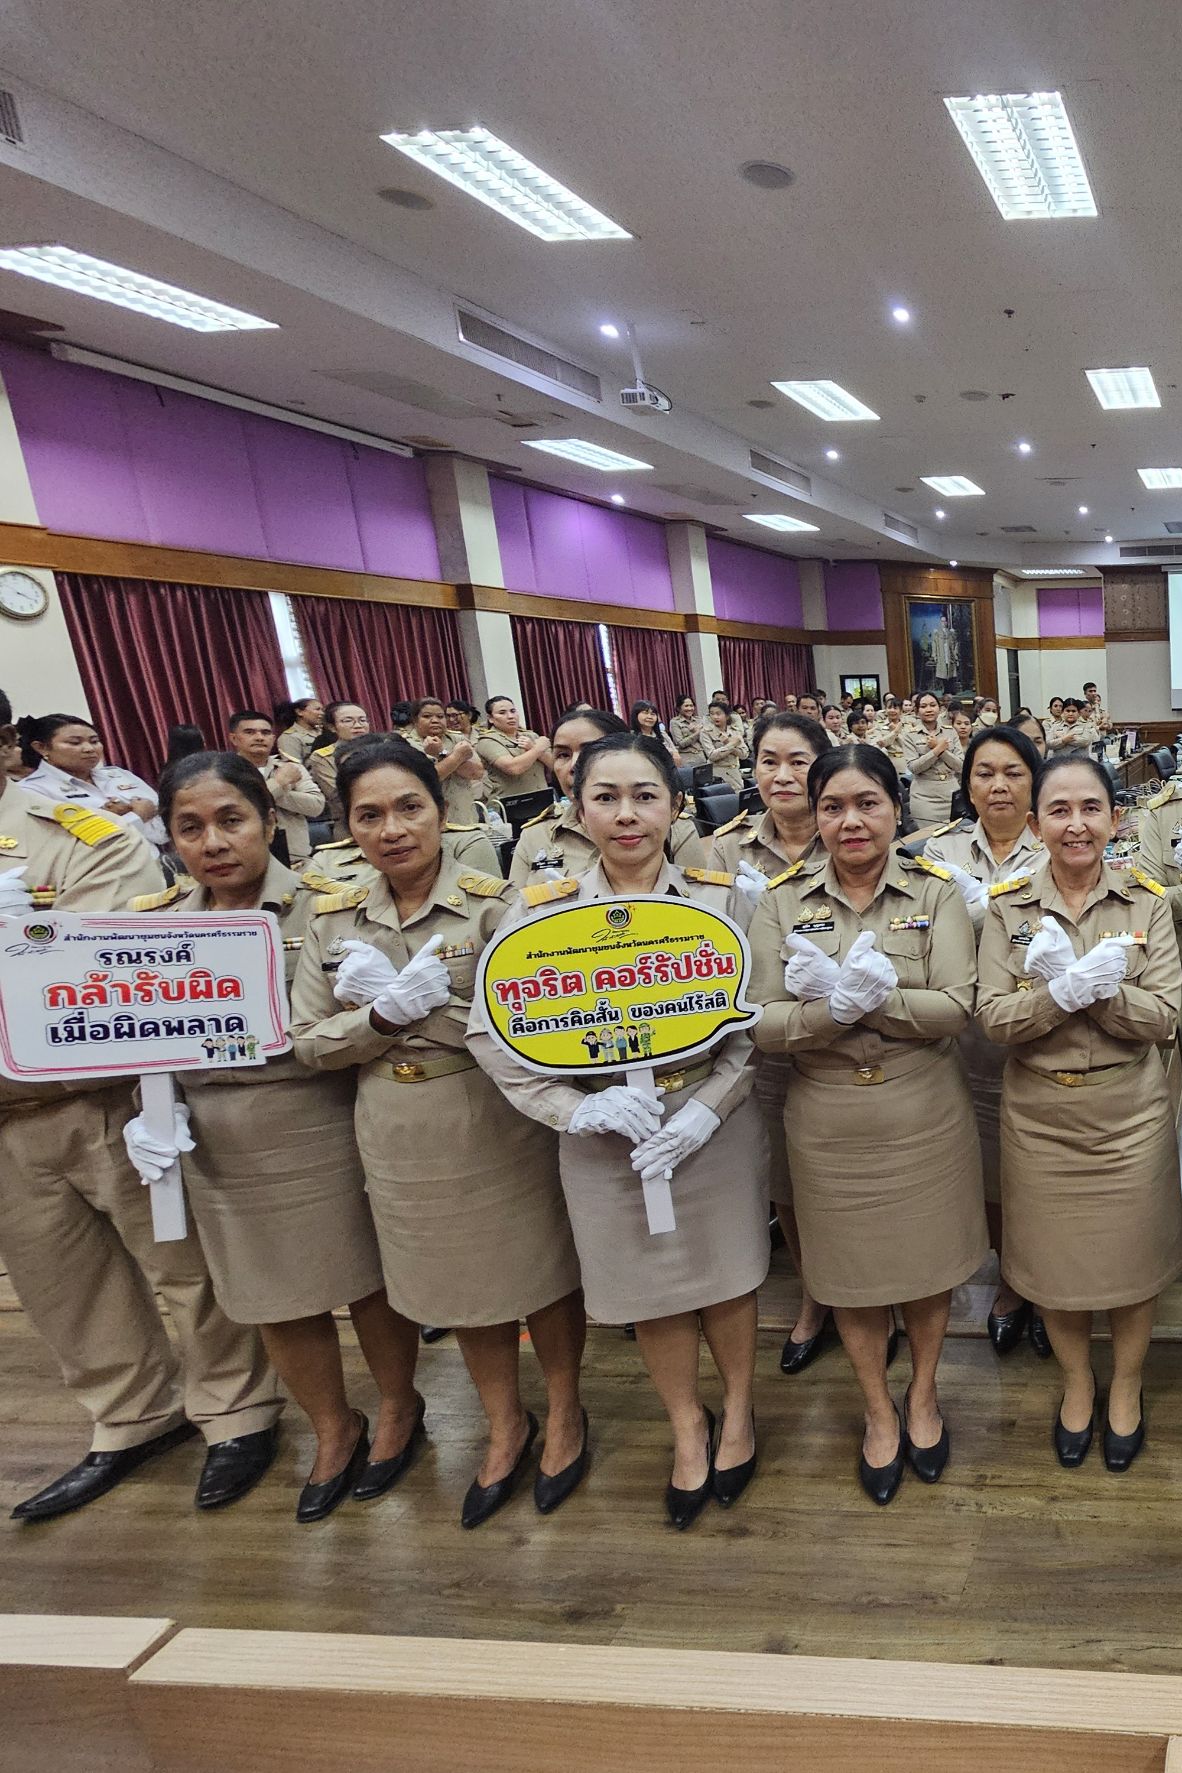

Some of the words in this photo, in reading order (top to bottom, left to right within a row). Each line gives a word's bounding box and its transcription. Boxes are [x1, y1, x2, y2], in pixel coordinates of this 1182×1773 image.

[63, 930, 258, 942] สำนักงานพัฒนาชุมชนจังหวัดนครศรีธรรมราช
[525, 933, 706, 960] สำนักงานพัฒนาชุมชนจังหวัดนครศรีธรรมราช
[99, 942, 193, 966] รณรงค์
[46, 969, 242, 1008] กล้ารับผิด
[496, 967, 583, 1012] ทุจริต
[595, 942, 736, 990] คอร์รัปชั่น
[50, 1011, 246, 1045] เมื่อผิดพลาด
[511, 999, 620, 1035] คือการคิดสั้น
[631, 990, 727, 1021] ของคนไร้สติ
